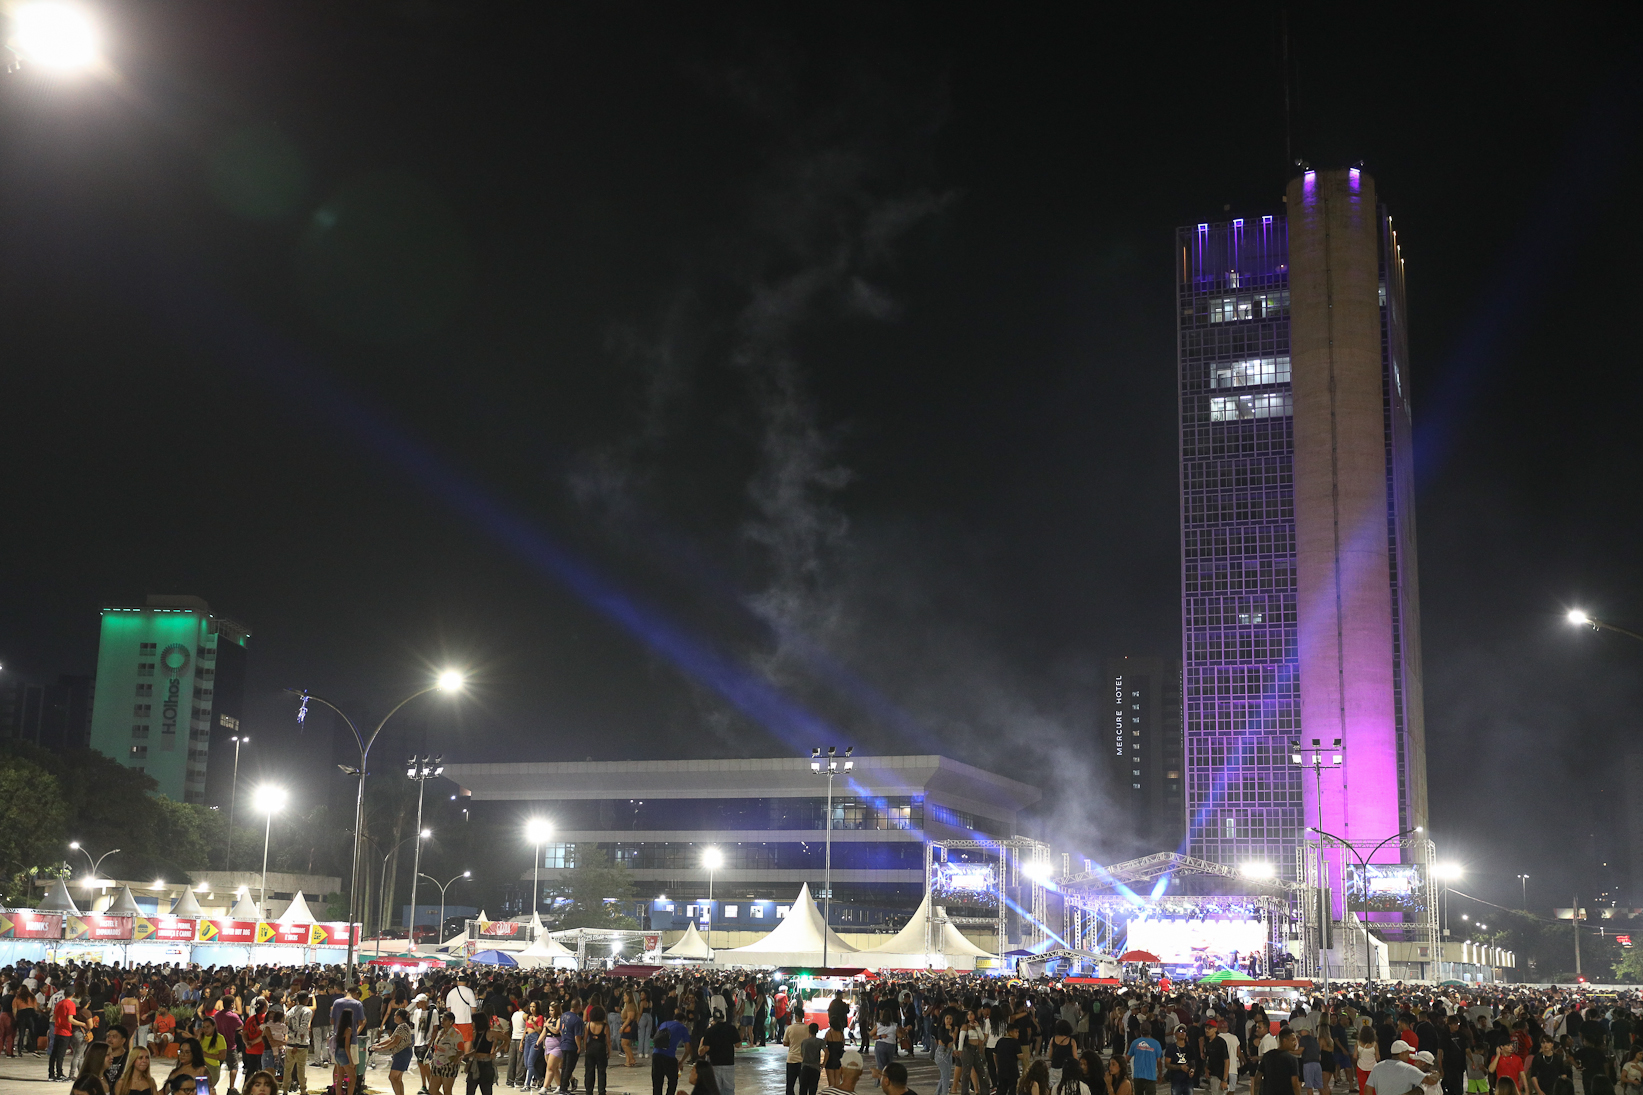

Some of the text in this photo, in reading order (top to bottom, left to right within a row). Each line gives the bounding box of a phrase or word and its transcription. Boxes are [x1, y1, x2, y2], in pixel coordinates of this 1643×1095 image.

[161, 678, 180, 735] H.Olhos
[1115, 675, 1123, 756] MERCURE HOTEL
[26, 921, 49, 931] DRINKS
